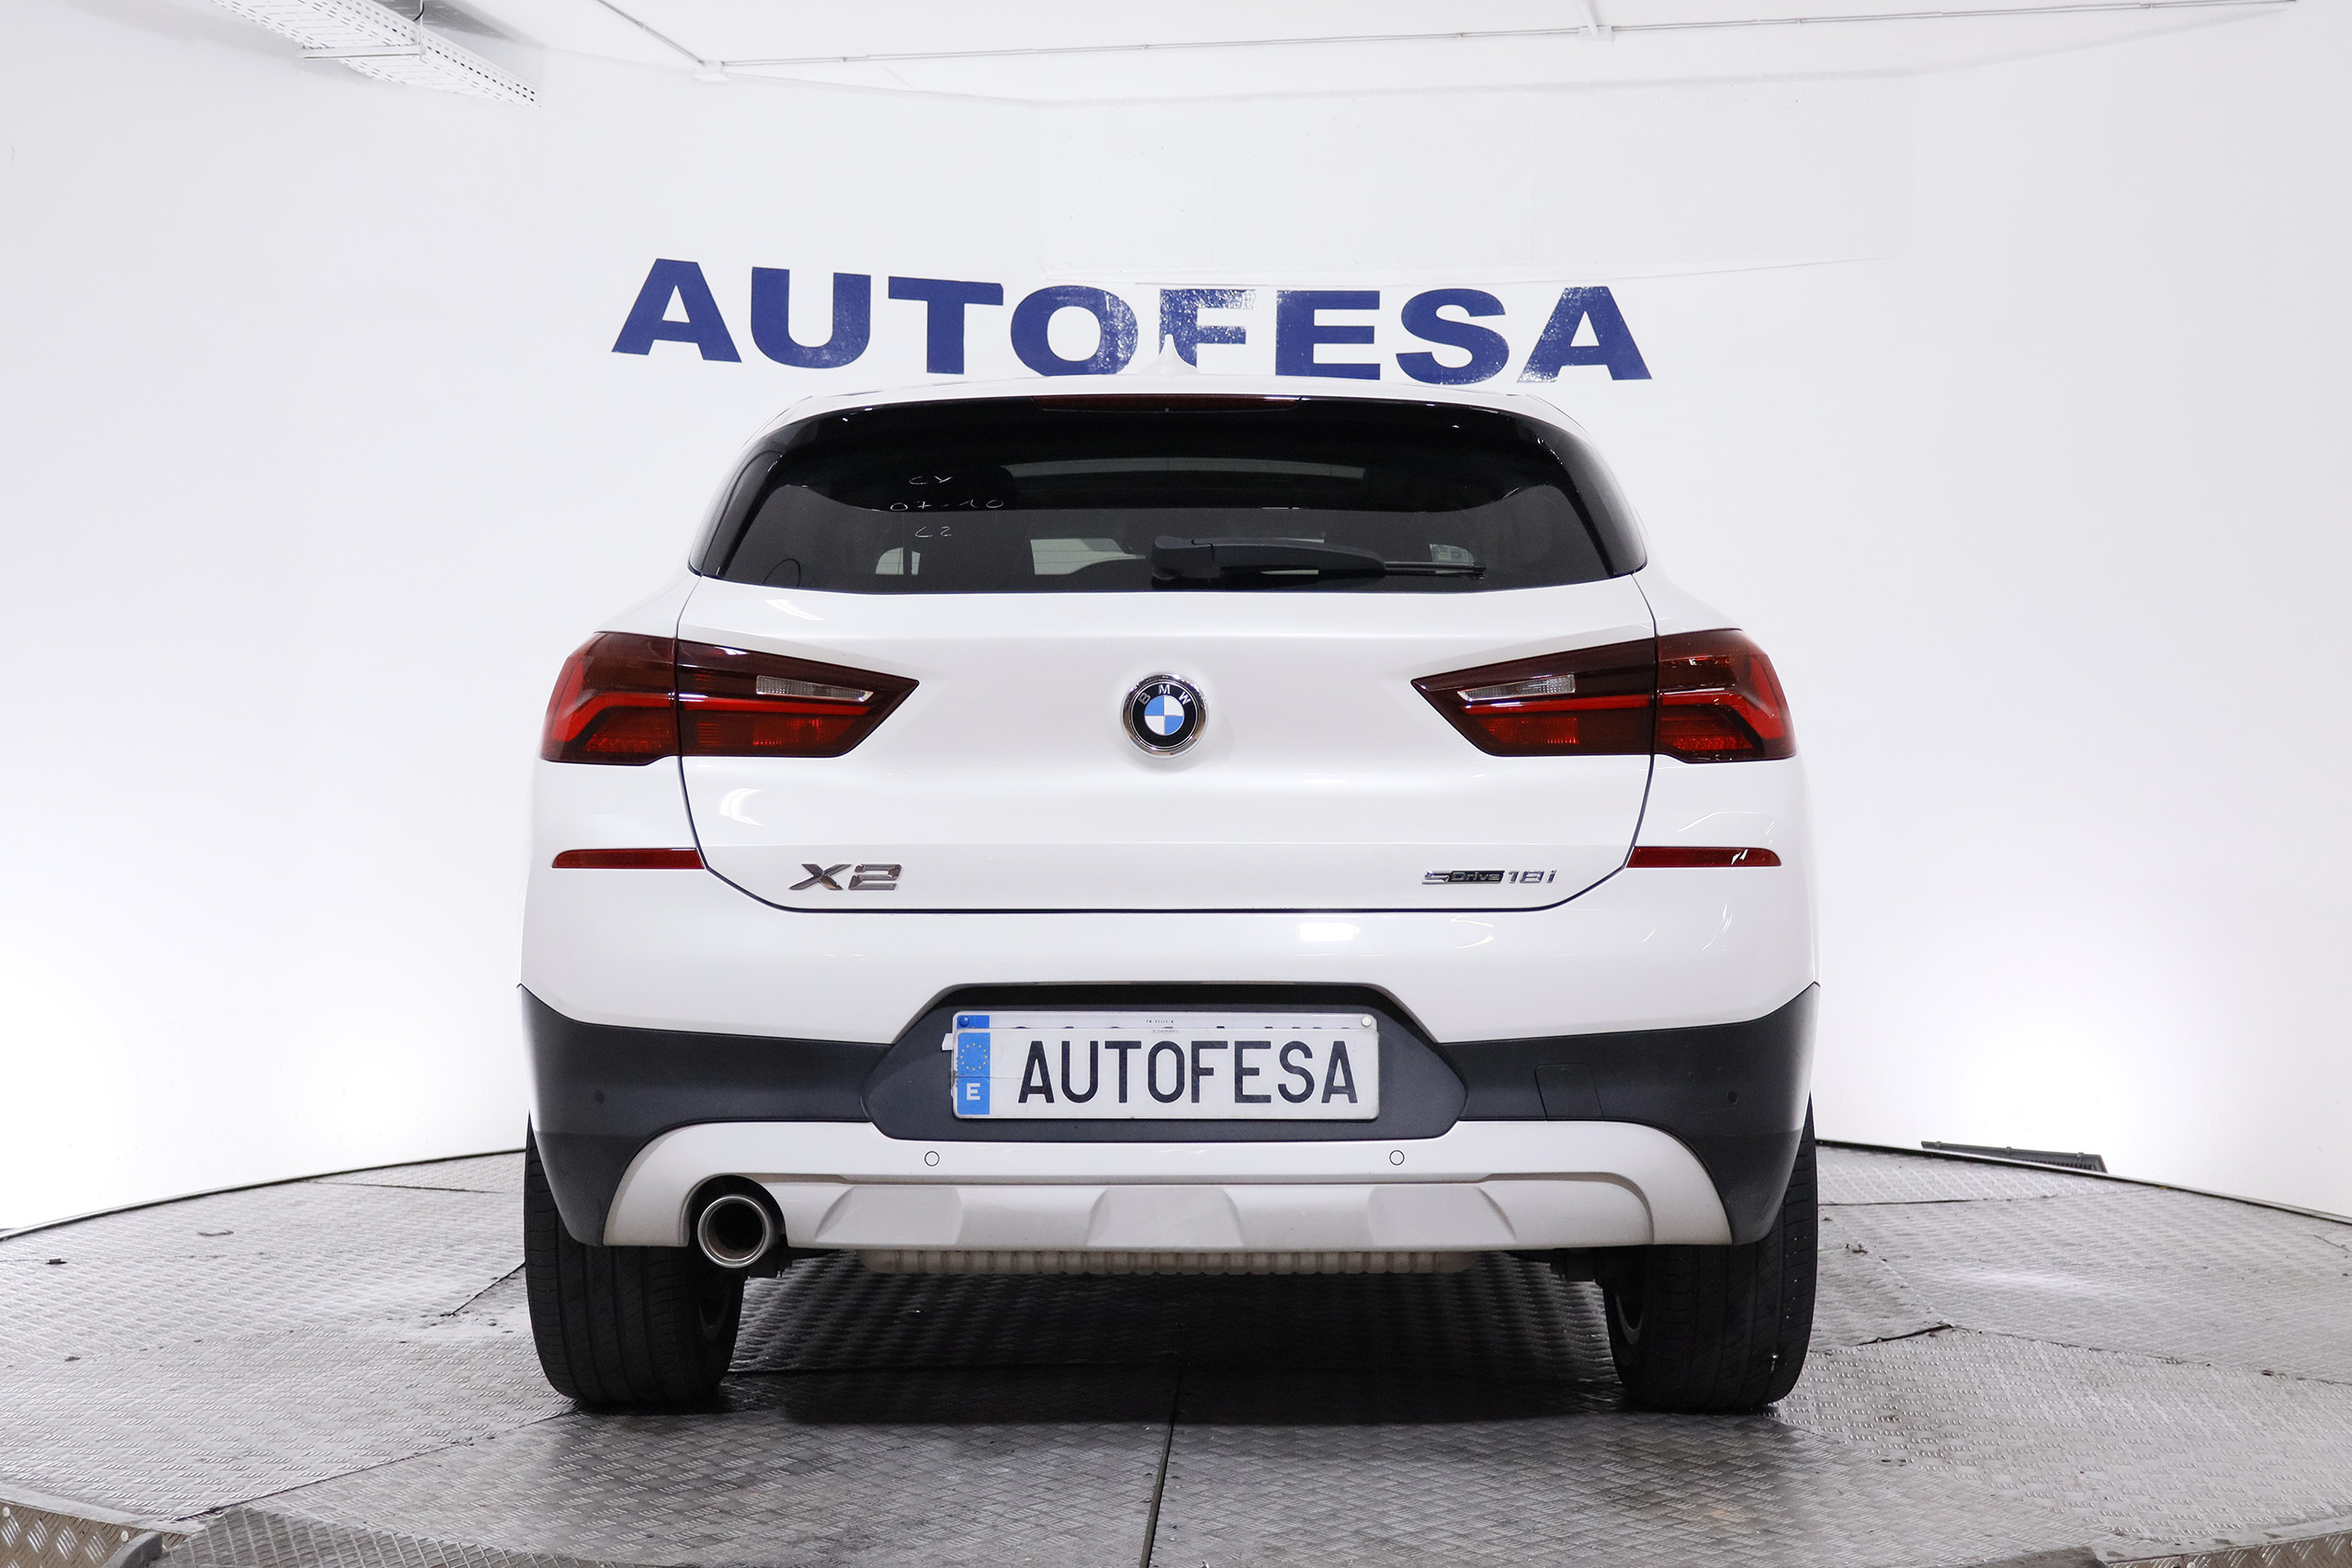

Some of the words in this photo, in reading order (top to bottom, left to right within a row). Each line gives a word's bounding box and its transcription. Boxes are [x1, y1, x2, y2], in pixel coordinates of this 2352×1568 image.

[613, 258, 1652, 385] AUTOFESA
[1137, 683, 1193, 705] BMW
[788, 863, 903, 891] X2
[1017, 1040, 1359, 1104] AUTOFESA
[967, 1082, 981, 1100] E
